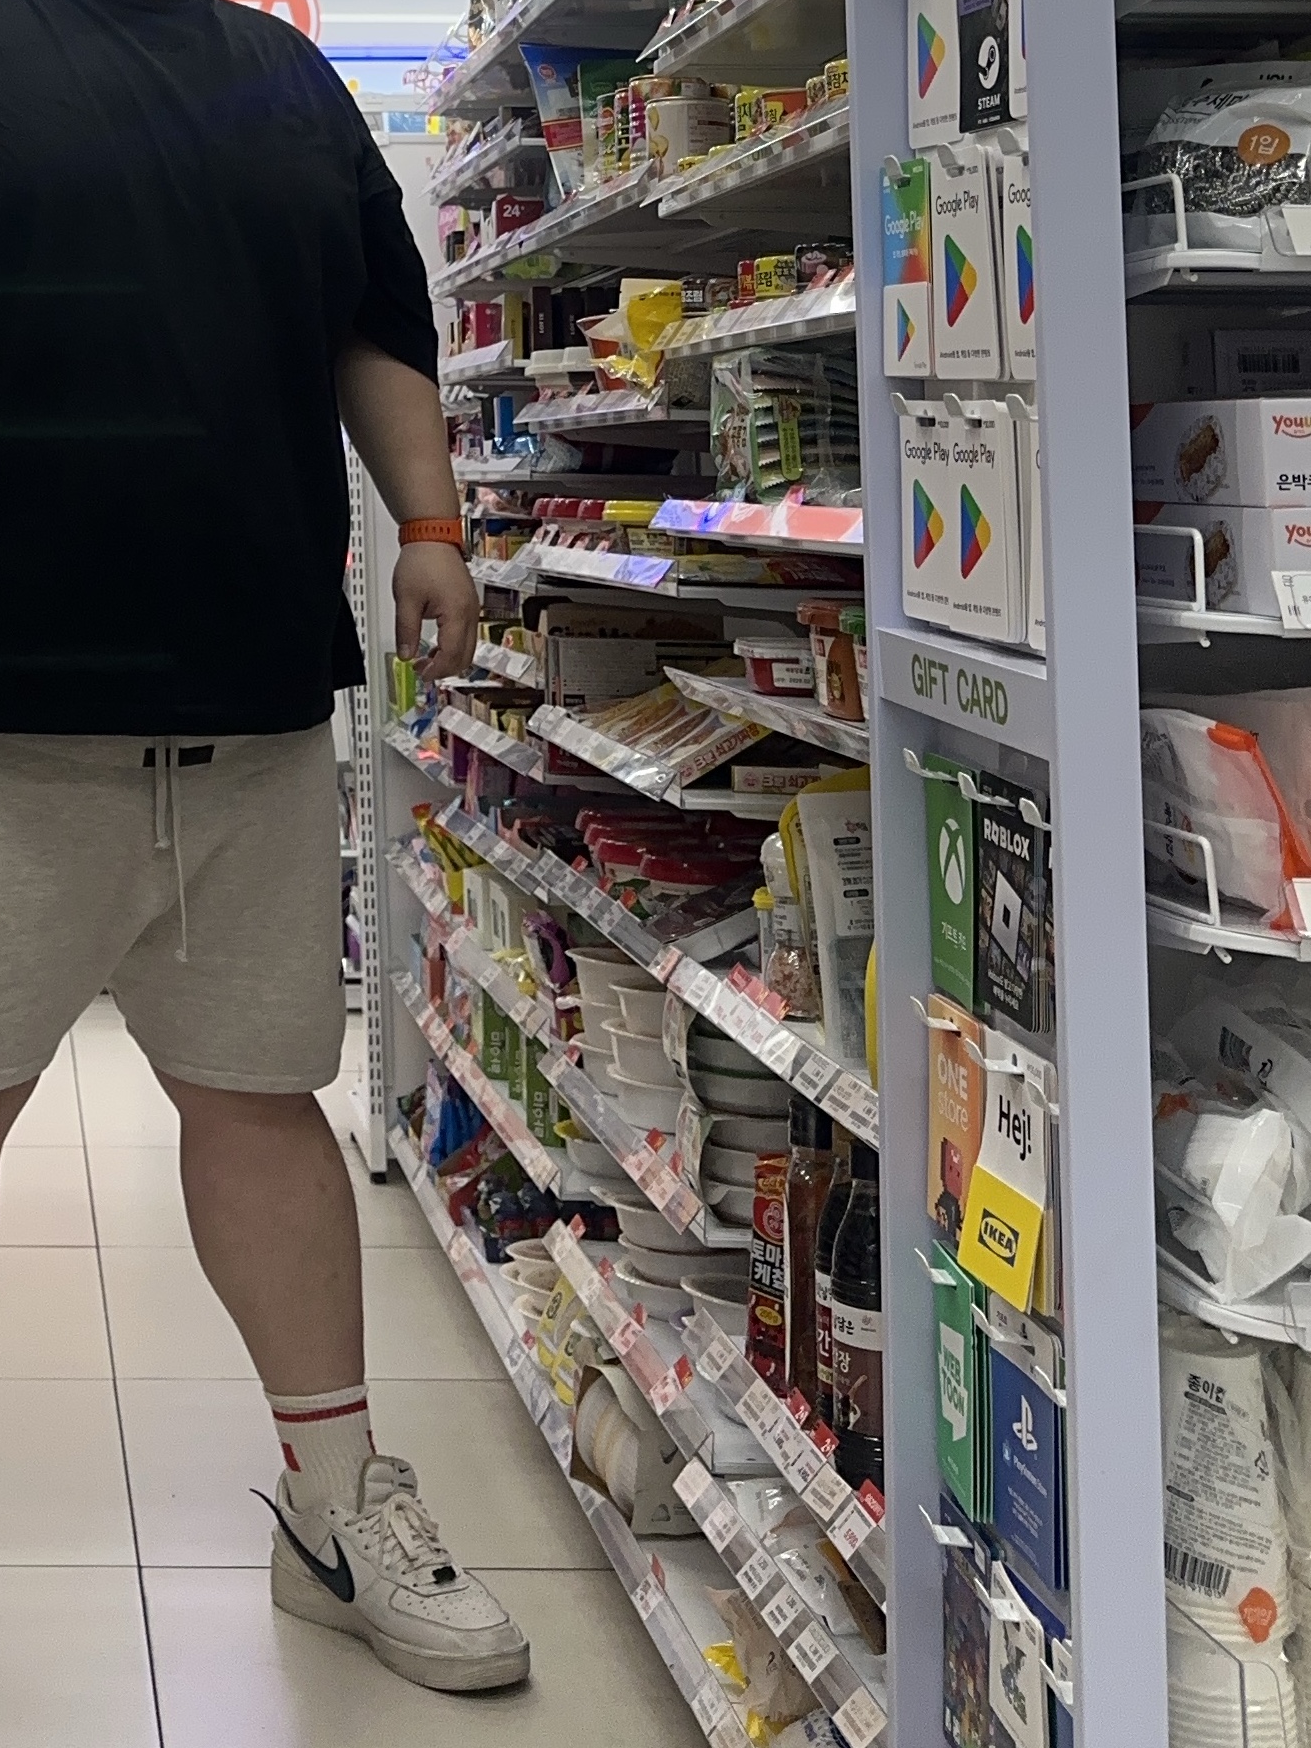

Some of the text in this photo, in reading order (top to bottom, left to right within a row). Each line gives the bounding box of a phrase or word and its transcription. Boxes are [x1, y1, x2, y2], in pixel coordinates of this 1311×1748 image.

[977, 93, 1002, 111] STEAM
[935, 189, 980, 218] Google Play
[1007, 182, 1031, 208] Goog
[884, 209, 925, 239] Google Play
[904, 438, 950, 467] Google Play
[952, 441, 996, 470] Google Play
[911, 652, 1010, 727] GIFT CARD
[983, 817, 1031, 862] ROBLOX
[937, 1053, 969, 1101] ONE
[937, 1091, 970, 1133] store
[998, 1094, 1032, 1162] Hej!
[752, 1240, 785, 1265] 토마
[983, 1220, 1015, 1254] IKEA
[817, 1329, 832, 1358] 간
[942, 1343, 962, 1387] WEB
[941, 1372, 967, 1418] TOON
